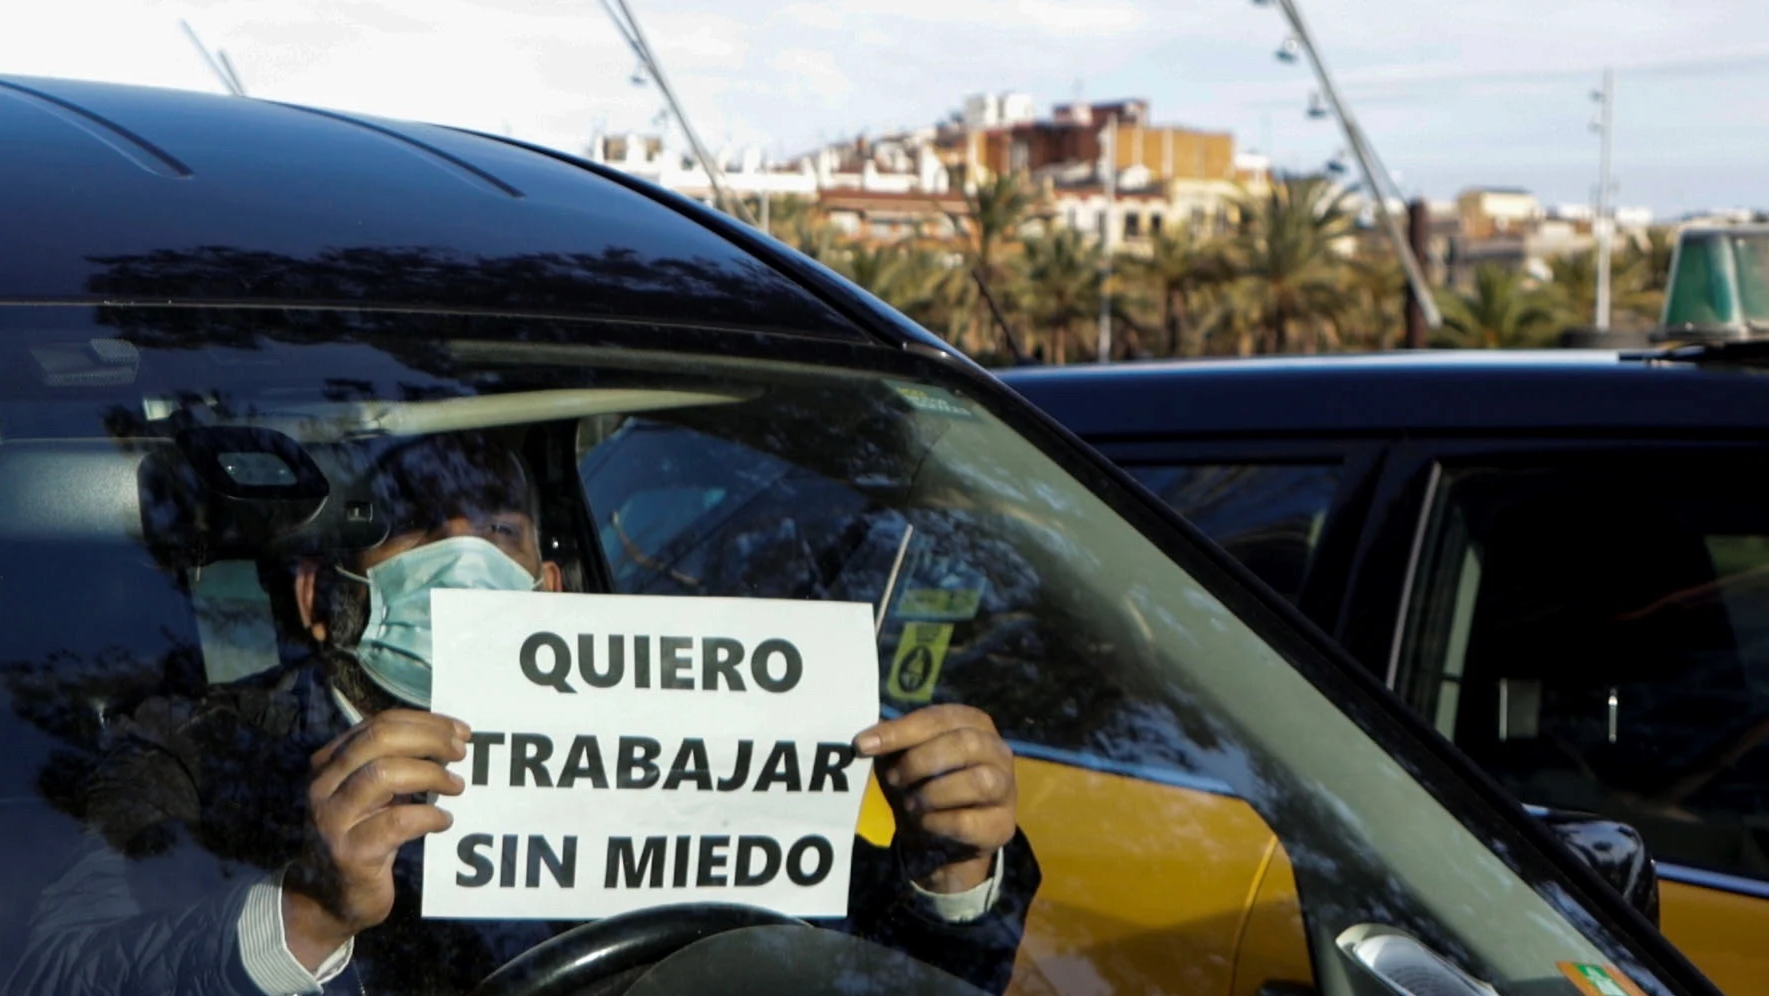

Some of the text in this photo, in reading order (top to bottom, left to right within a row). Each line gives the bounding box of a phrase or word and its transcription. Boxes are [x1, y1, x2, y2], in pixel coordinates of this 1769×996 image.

[519, 632, 803, 692] QUIERO
[468, 731, 856, 792] TRABAJAR
[456, 834, 834, 888] SIN MIEDO
